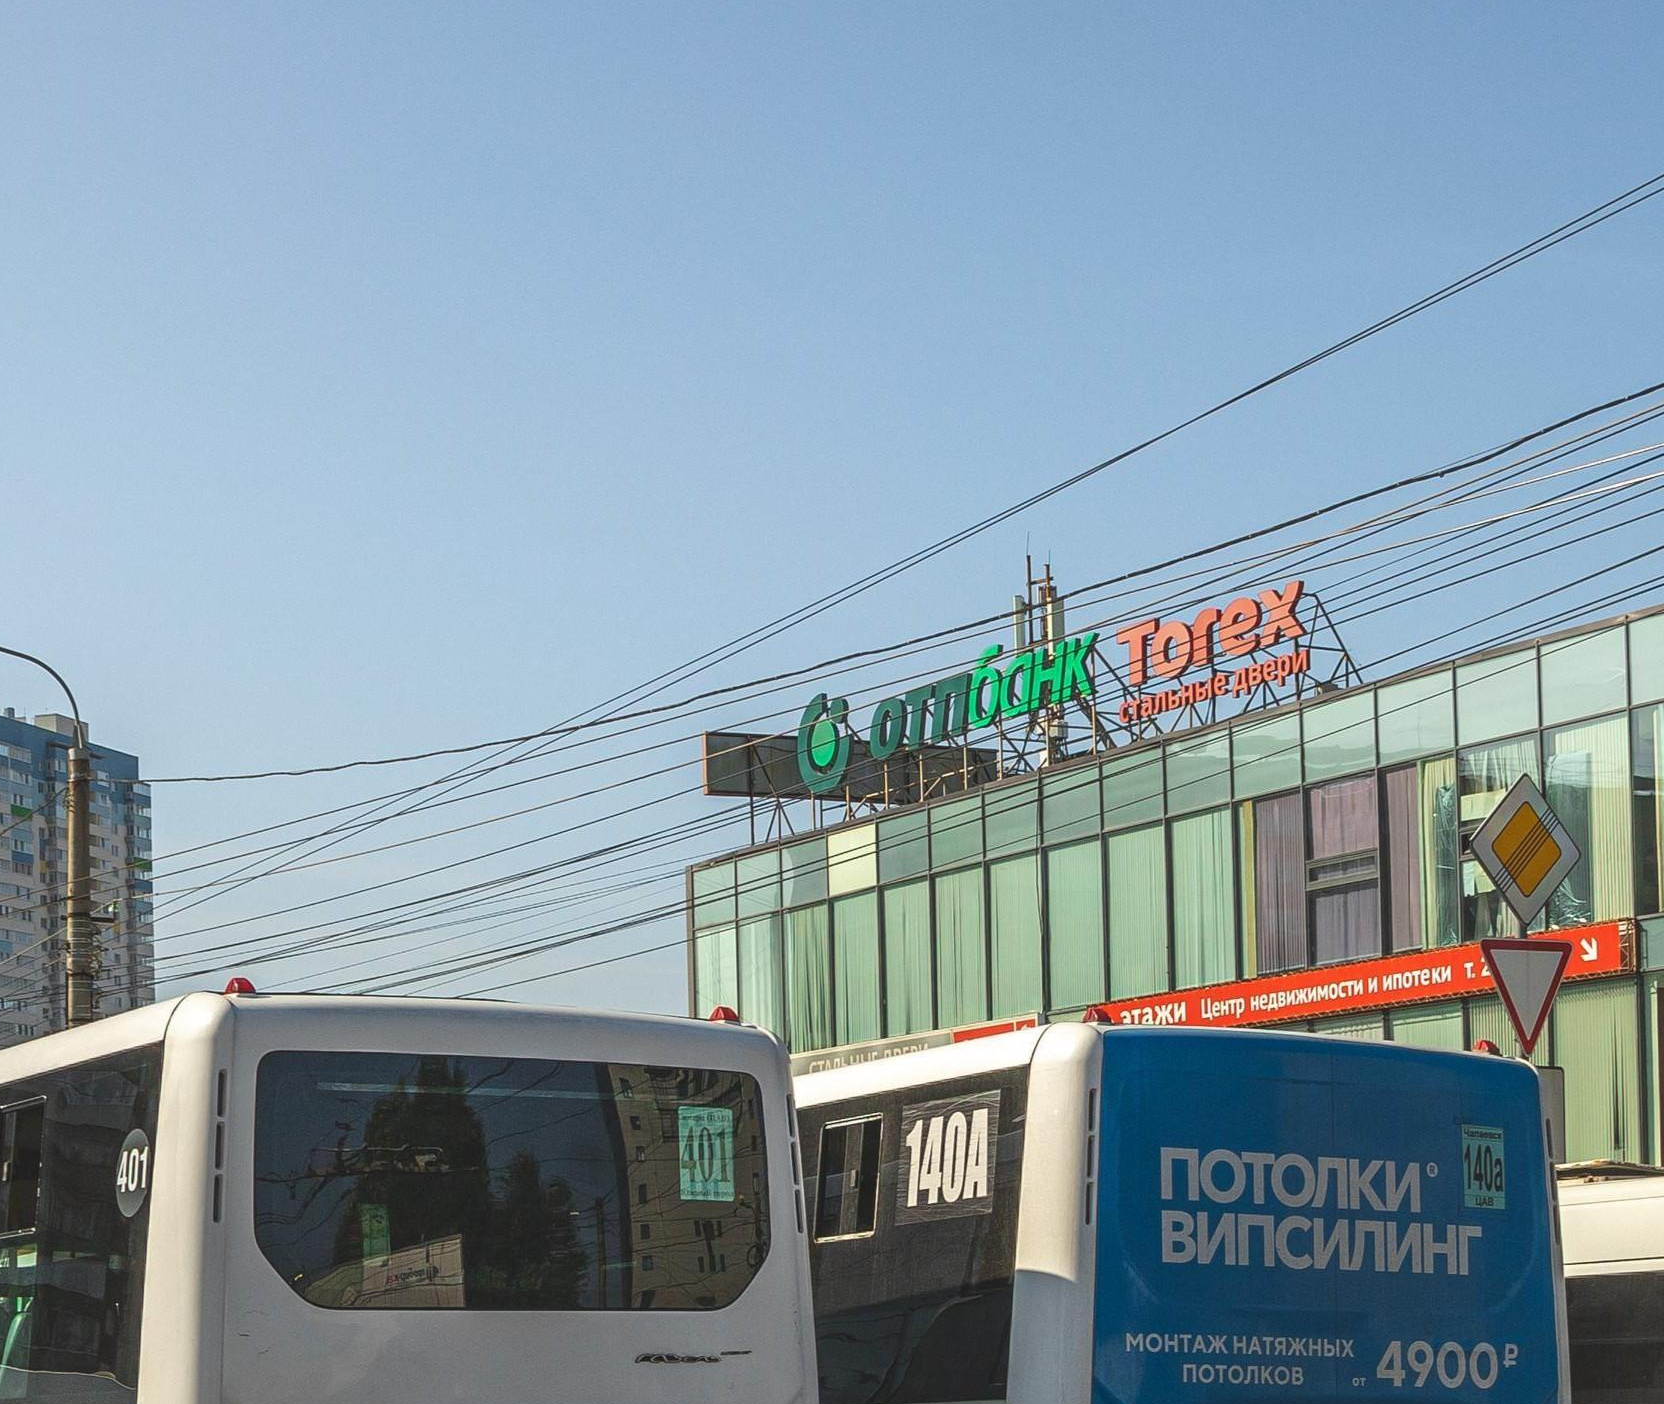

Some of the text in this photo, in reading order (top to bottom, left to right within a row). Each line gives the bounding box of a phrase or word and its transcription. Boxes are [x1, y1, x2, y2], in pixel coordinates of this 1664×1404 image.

[1116, 579, 1308, 688] Torex
[1119, 648, 1311, 723] стальные двери
[1120, 1000, 1188, 1026] этажи
[1200, 991, 1246, 1022] Центр
[1250, 978, 1364, 1012] недвижимости
[1368, 976, 1379, 992] и
[1382, 965, 1453, 992] ипотеки
[117, 1146, 149, 1193] 401
[681, 1126, 731, 1183] 401
[906, 1107, 989, 1208] 140А
[1160, 1146, 1421, 1213] ПОТОЛКИ
[1475, 1196, 1495, 1207] ЦАВ
[1160, 1210, 1483, 1276] ВИПСИЛИНГ
[1124, 1332, 1355, 1358] МОНТАЖ НАТЯЖНЫХ
[1182, 1363, 1305, 1386] ПОТОЛКОВ
